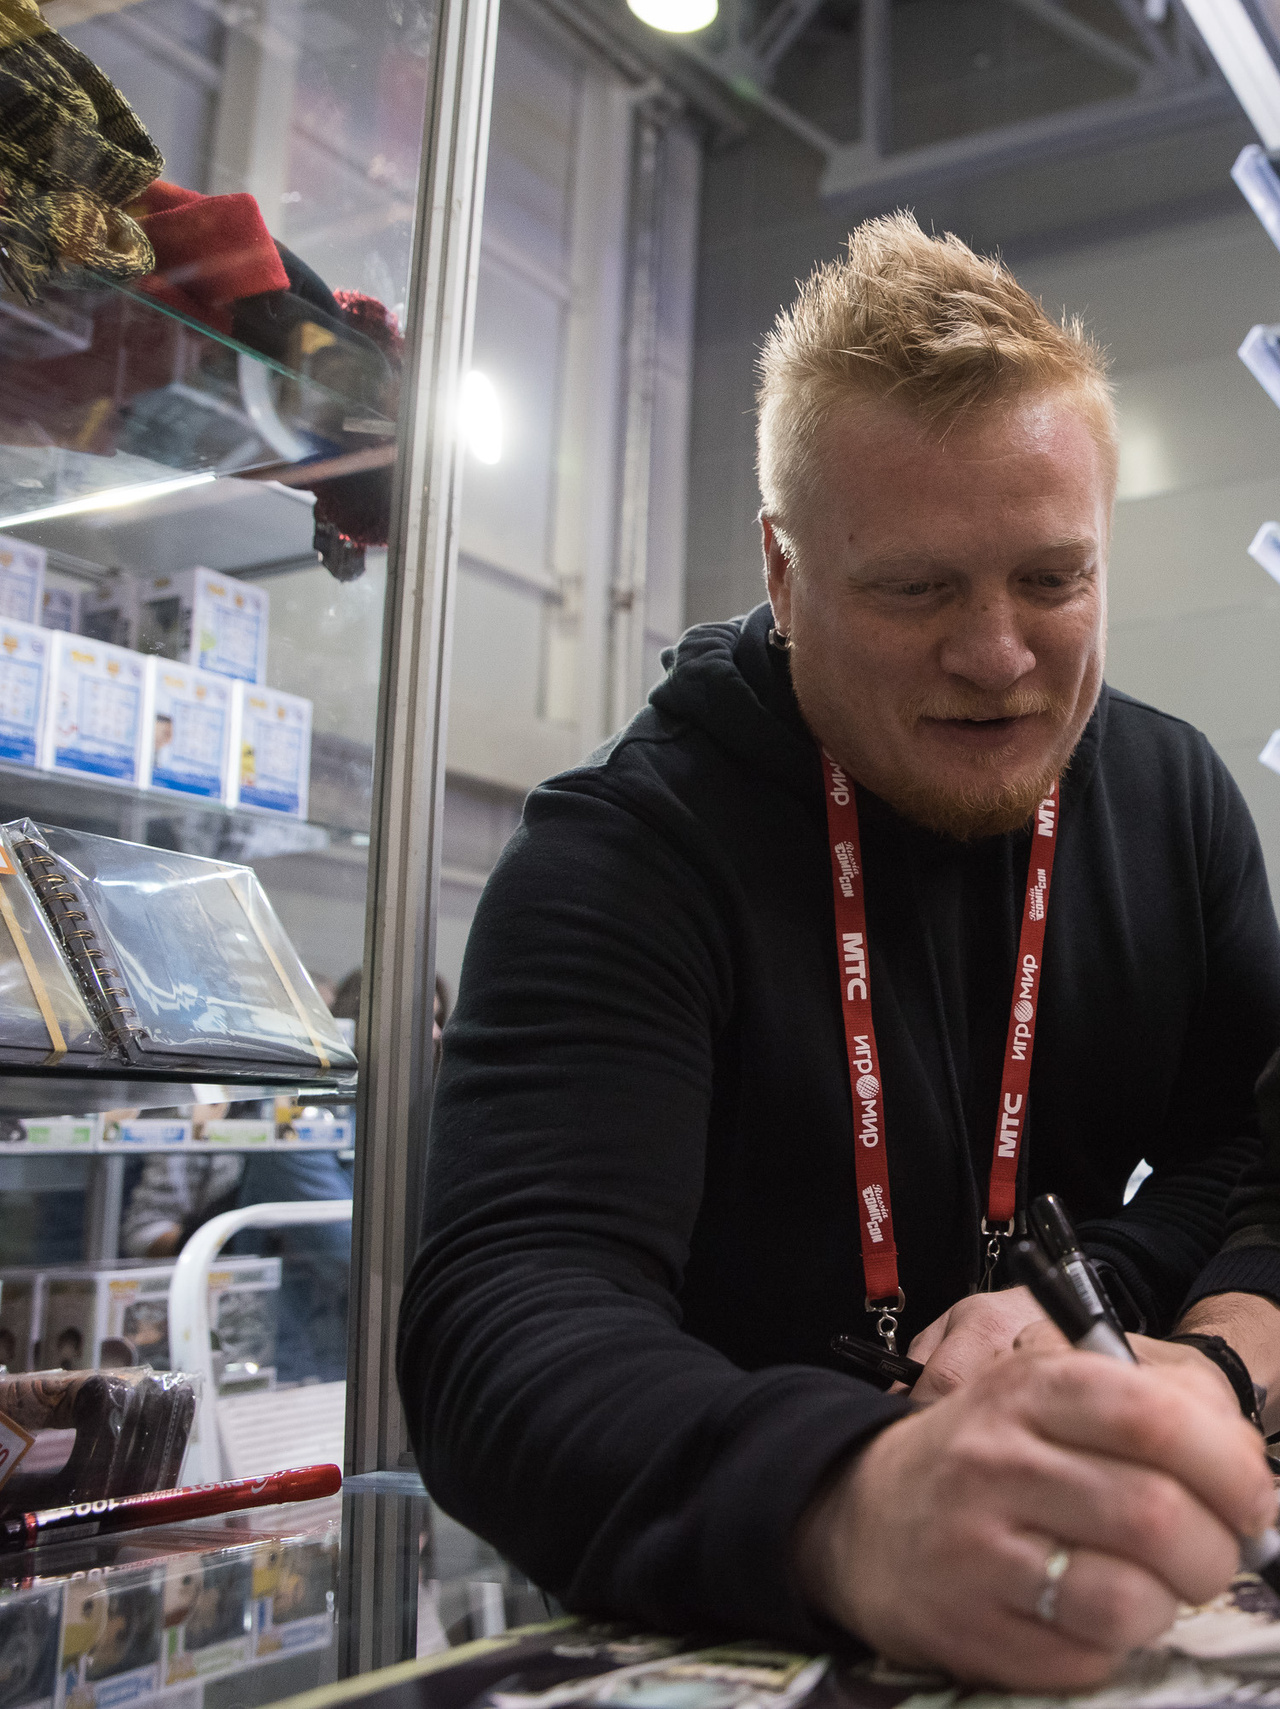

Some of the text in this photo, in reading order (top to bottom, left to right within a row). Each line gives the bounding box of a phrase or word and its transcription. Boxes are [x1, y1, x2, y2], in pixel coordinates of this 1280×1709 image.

[830, 757, 850, 806] мир
[844, 841, 860, 876] Russia
[842, 932, 868, 1000] МТС
[998, 1093, 1023, 1158] МТС
[862, 1185, 884, 1243] COMIC CON
[872, 1184, 889, 1219] Russia
[75, 1498, 119, 1517] 100
